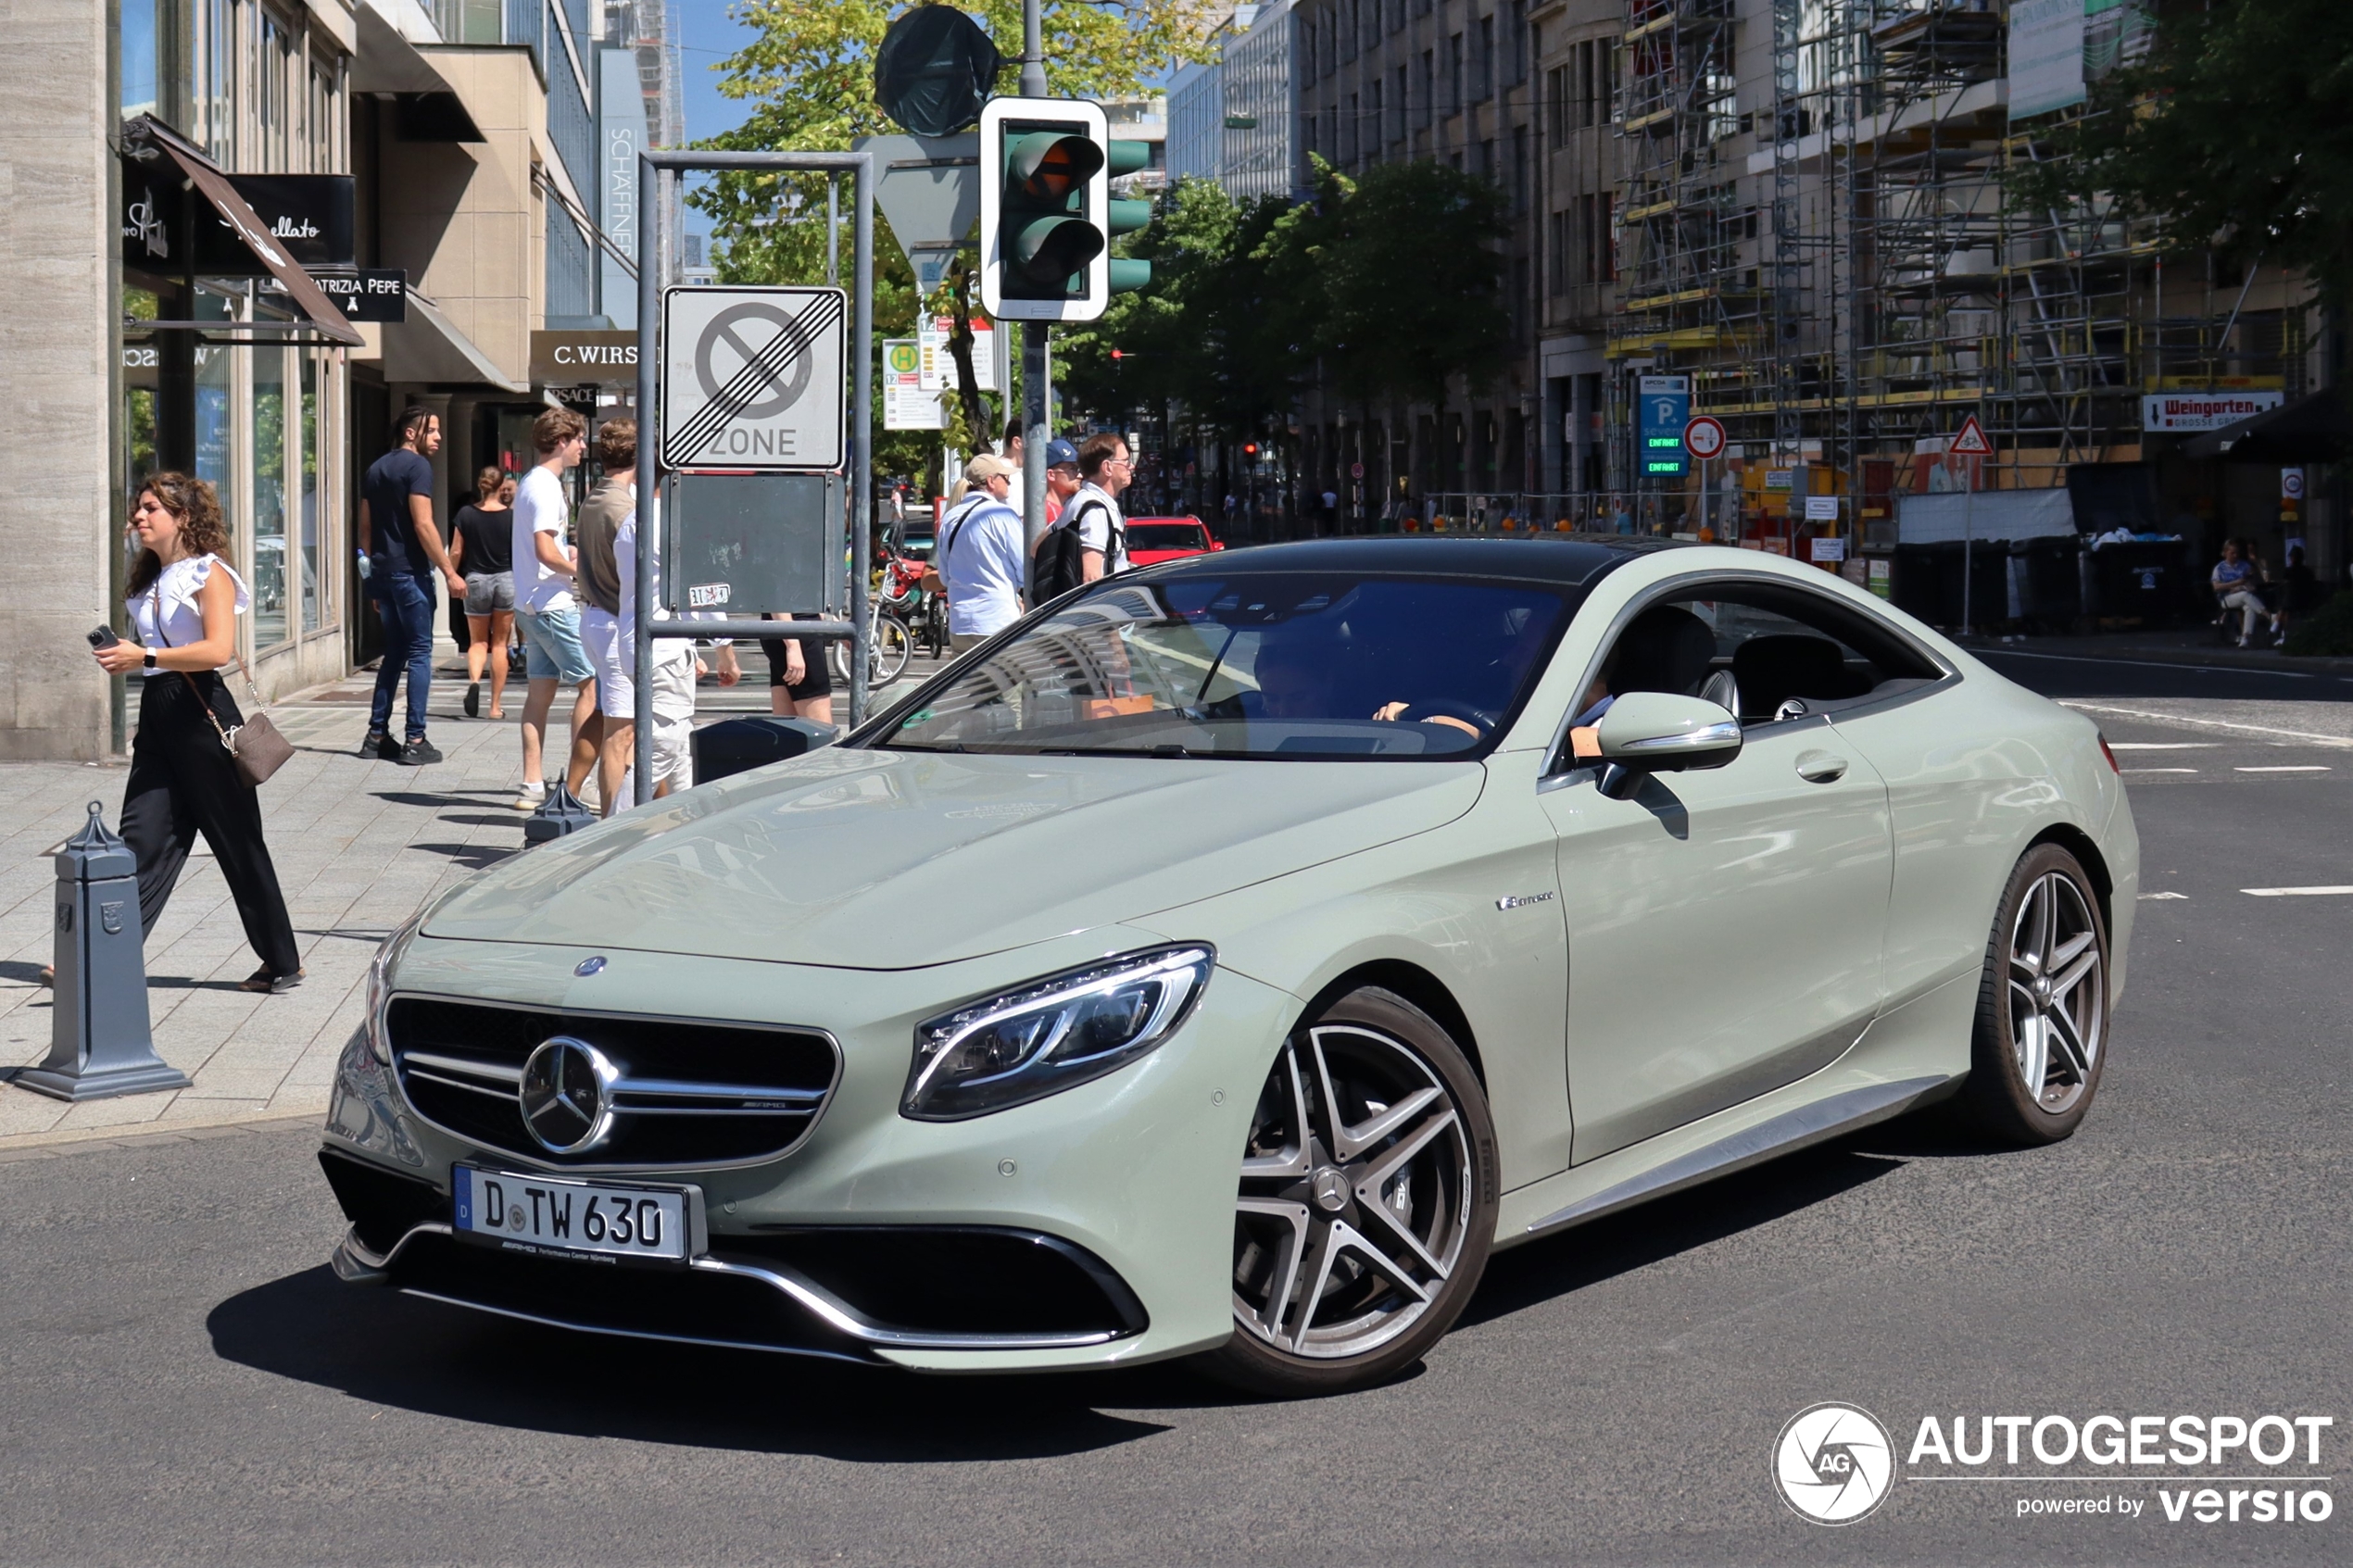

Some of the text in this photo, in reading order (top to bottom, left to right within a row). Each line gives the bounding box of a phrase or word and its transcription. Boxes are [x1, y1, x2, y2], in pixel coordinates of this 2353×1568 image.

[610, 128, 632, 258] SCHÄFFNER
[312, 278, 400, 295] ATRIZIA PEPE
[886, 374, 897, 384] 12
[2165, 399, 2254, 418] Weingarten
[709, 428, 797, 456] ZONE
[1649, 438, 1680, 447] EINFAHRT
[1649, 463, 1680, 472] EINFAHRT
[459, 1205, 468, 1219] D
[484, 1179, 662, 1248] D TW 630
[571, 1251, 590, 1261] Center
